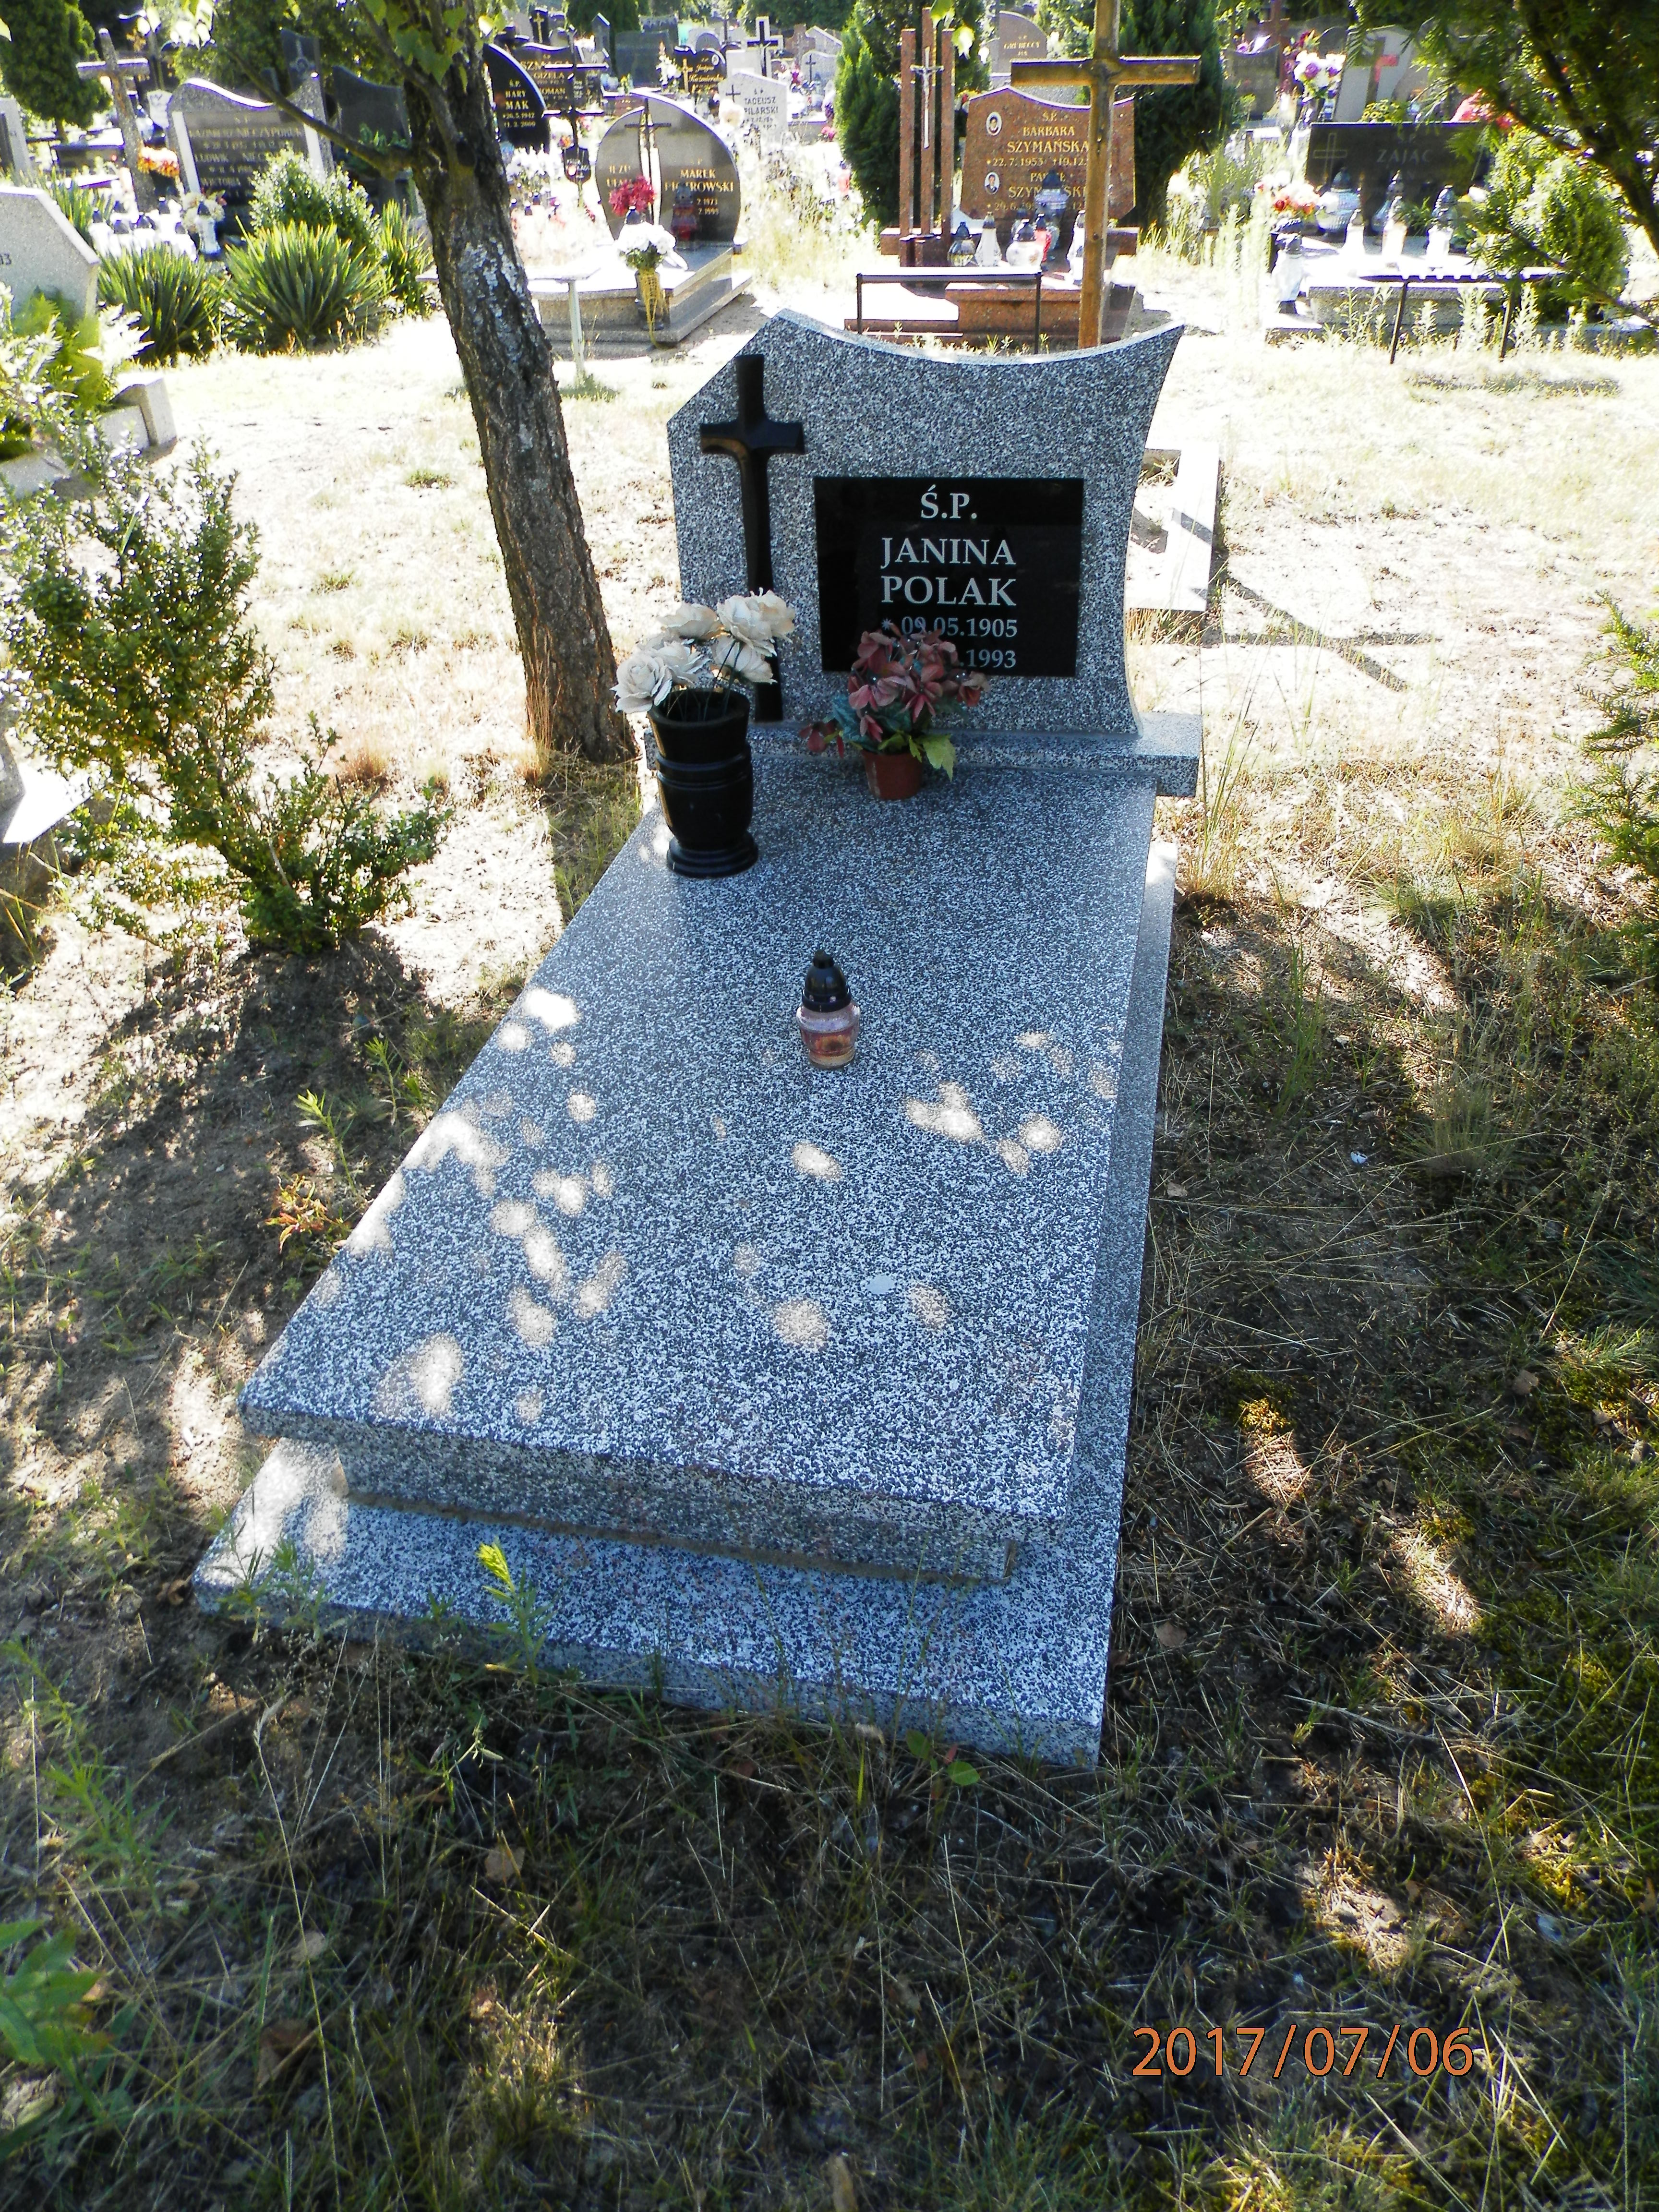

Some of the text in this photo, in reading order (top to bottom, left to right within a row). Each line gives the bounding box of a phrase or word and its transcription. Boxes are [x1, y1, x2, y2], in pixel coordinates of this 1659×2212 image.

[505, 100, 529, 110] MAK
[1023, 125, 1075, 137] BARBARA
[680, 169, 716, 179] MAREK
[920, 484, 977, 519] Ś.P.
[880, 537, 1016, 569] JANINA
[881, 576, 1017, 606] POLAK
